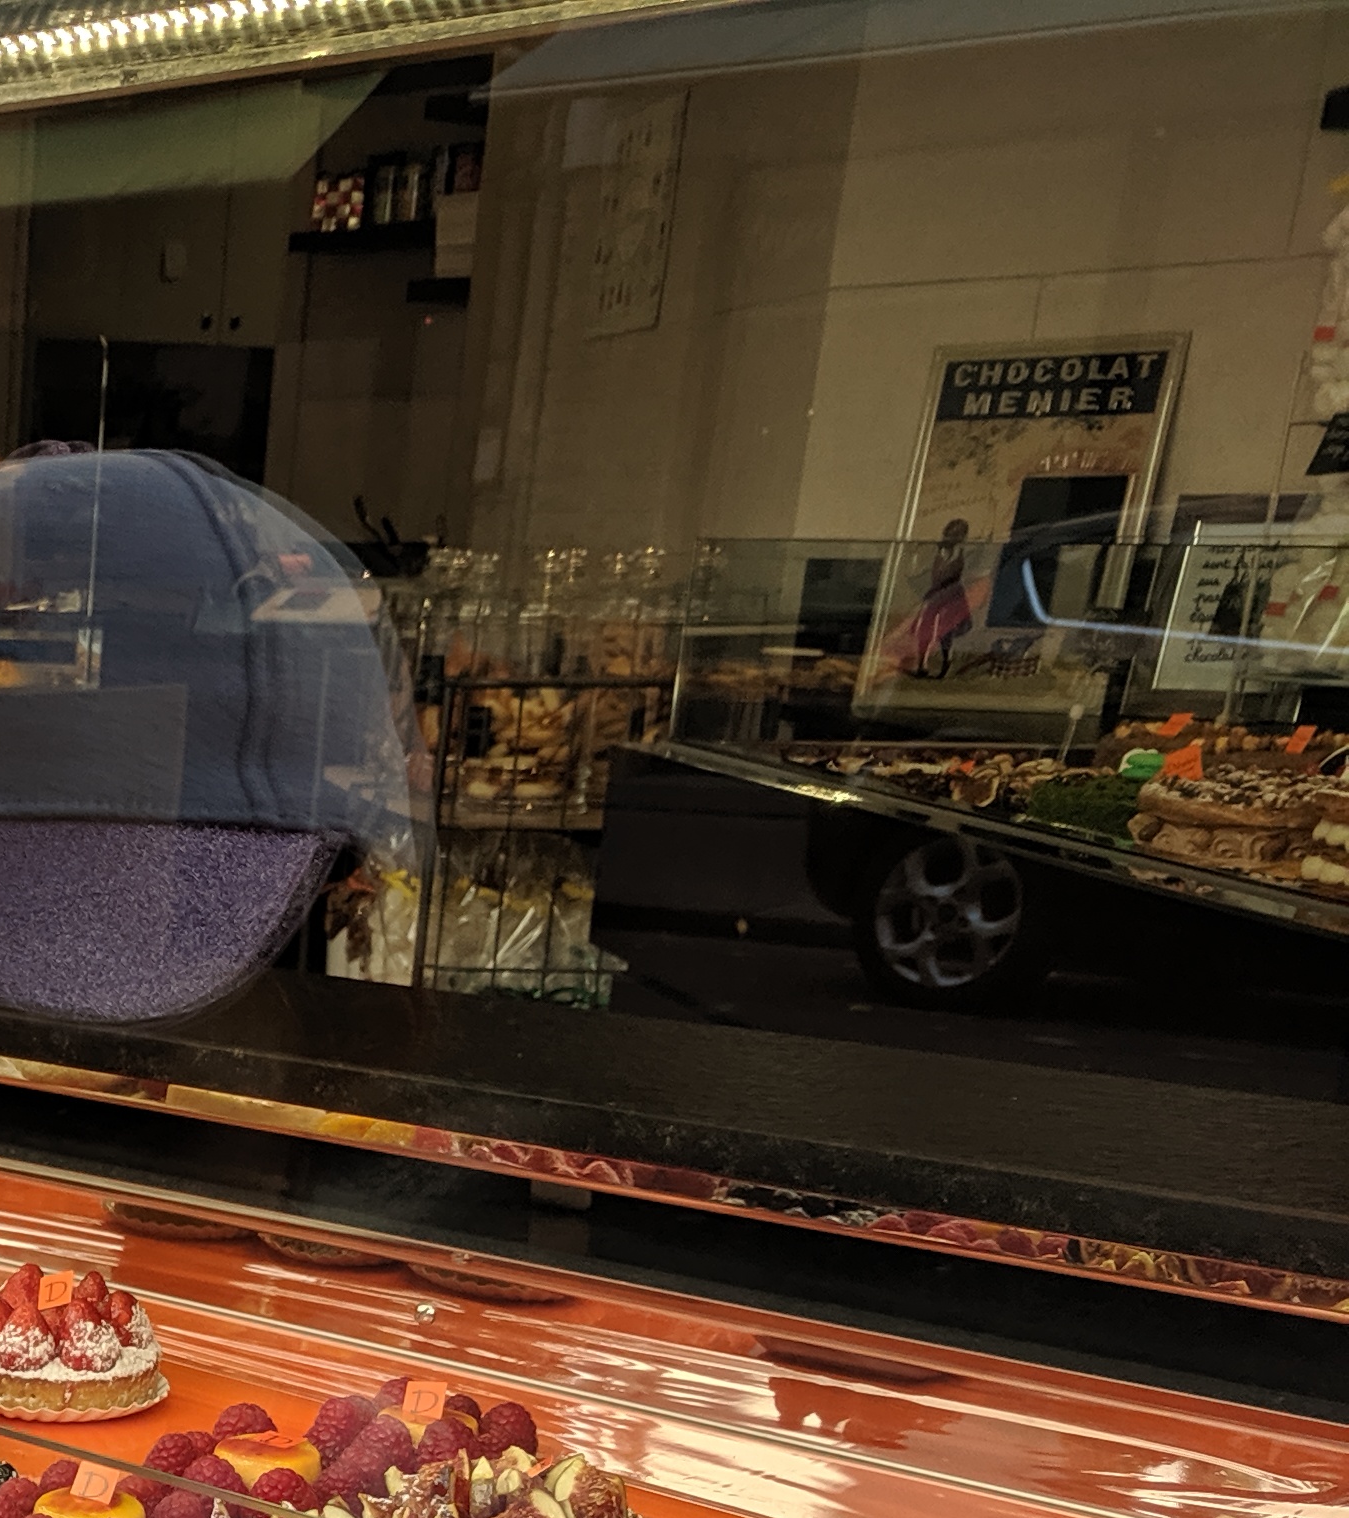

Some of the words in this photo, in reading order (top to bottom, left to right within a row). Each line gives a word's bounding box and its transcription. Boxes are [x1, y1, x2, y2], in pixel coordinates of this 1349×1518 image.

[954, 354, 1159, 388] CHOCOLAT
[962, 386, 1135, 416] MENIER
[44, 1281, 68, 1303] D
[409, 1389, 438, 1413] D
[79, 1471, 109, 1498] D
